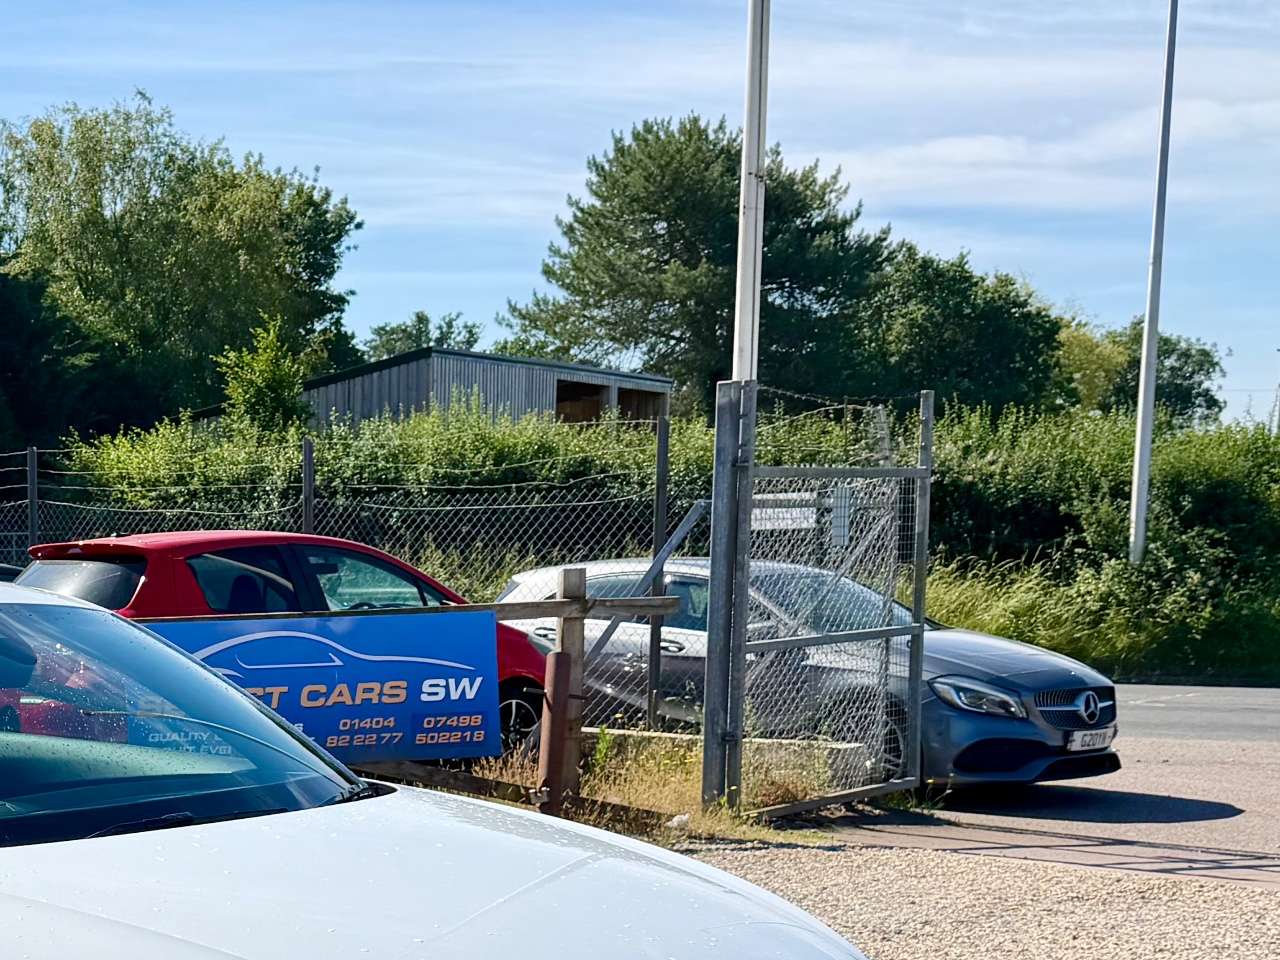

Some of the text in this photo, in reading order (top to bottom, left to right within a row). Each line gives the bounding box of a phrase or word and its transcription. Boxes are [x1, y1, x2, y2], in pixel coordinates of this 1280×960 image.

[300, 680, 408, 708] CARS
[420, 676, 483, 702] SW
[338, 716, 395, 731] 01404
[423, 714, 483, 729] 07498
